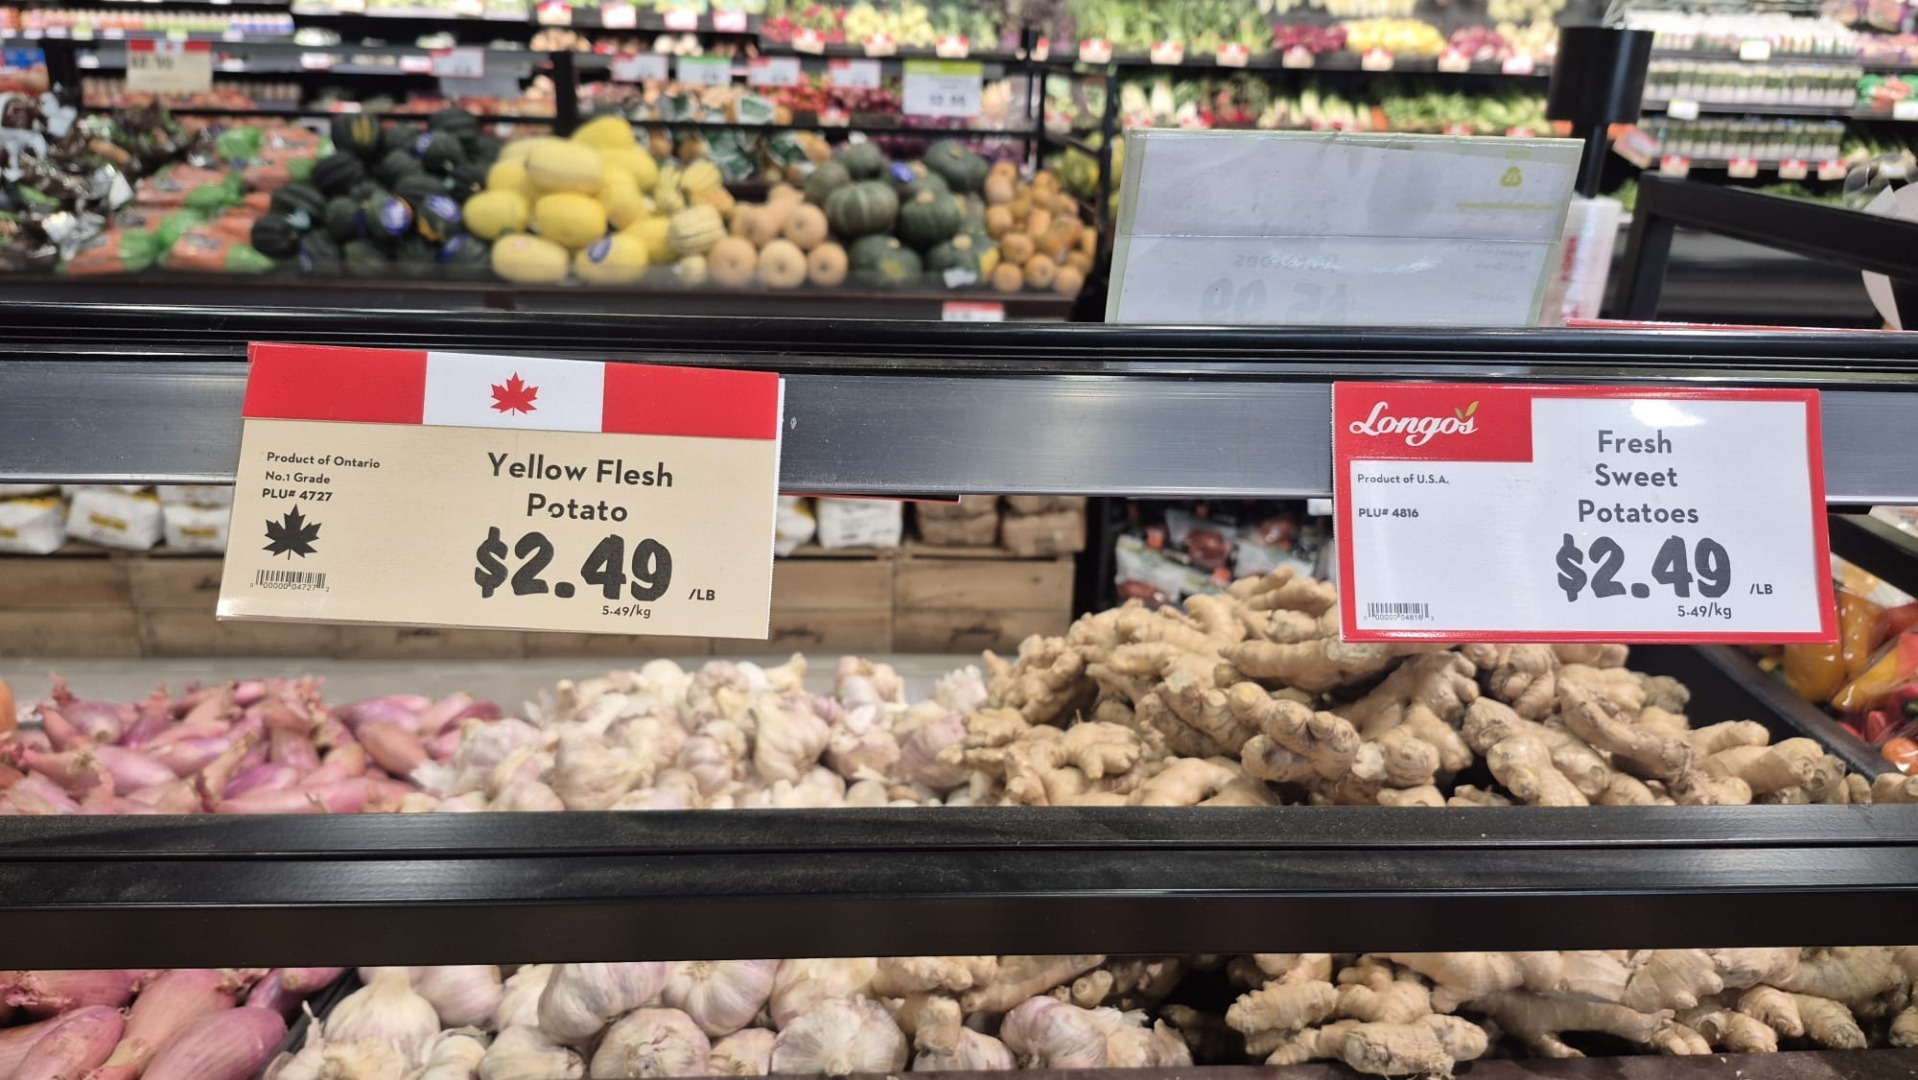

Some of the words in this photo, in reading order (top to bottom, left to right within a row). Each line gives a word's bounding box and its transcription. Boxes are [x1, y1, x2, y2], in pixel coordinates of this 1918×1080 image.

[1598, 429, 1672, 454] Fresh
[266, 452, 315, 465] Product
[317, 454, 331, 466] of
[333, 456, 381, 469] Ontario
[265, 471, 290, 482] No.1
[293, 472, 331, 485] Grade
[488, 452, 587, 482] Yellow
[596, 458, 673, 488] Flesh
[1595, 463, 1678, 487] Sweet
[1357, 473, 1400, 484] Product
[1403, 473, 1414, 484] of
[1416, 474, 1450, 485] U.S.A.
[262, 488, 296, 500] PLU#
[299, 490, 333, 502] 4727
[526, 492, 628, 522] Potato
[1358, 508, 1389, 518] PLU#
[1391, 508, 1419, 518] 4816
[1578, 499, 1699, 524] Potatoes
[474, 526, 673, 602] $2.49
[1556, 533, 1731, 603] $2.49
[688, 588, 716, 601] /LB
[1749, 583, 1773, 595] /LB
[602, 604, 652, 619] 5.49/kg
[1677, 602, 1732, 619] 5.49/kg
